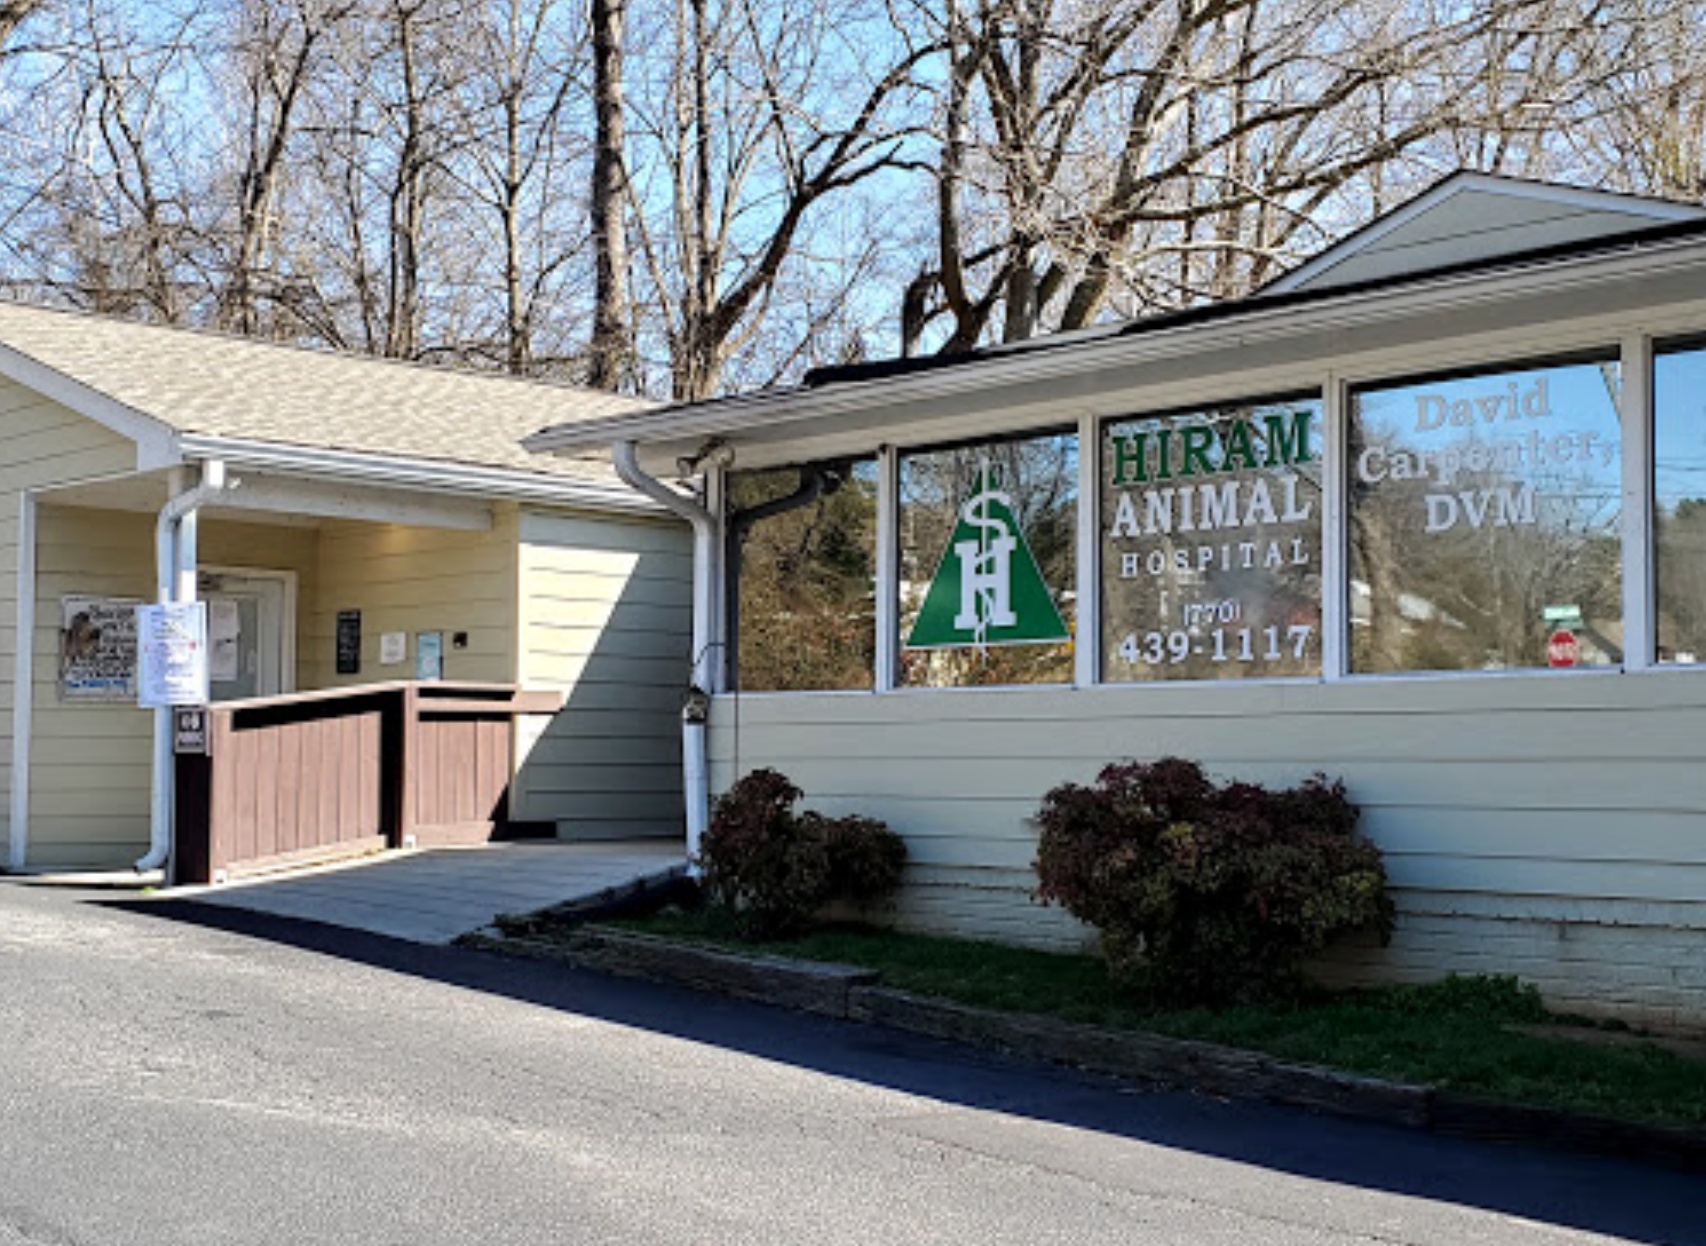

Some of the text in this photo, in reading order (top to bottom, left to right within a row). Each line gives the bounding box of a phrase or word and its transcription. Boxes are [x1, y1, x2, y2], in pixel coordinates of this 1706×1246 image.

[1414, 377, 1552, 432] David
[1112, 410, 1313, 485] HIRAM
[1357, 429, 1612, 486] Carpenter,
[1109, 474, 1313, 537] ANIMAL
[1423, 481, 1537, 533] DVM
[1120, 538, 1309, 579] HOSPITAL
[1183, 599, 1241, 627] (770)
[1118, 624, 1312, 664] 439-1117
